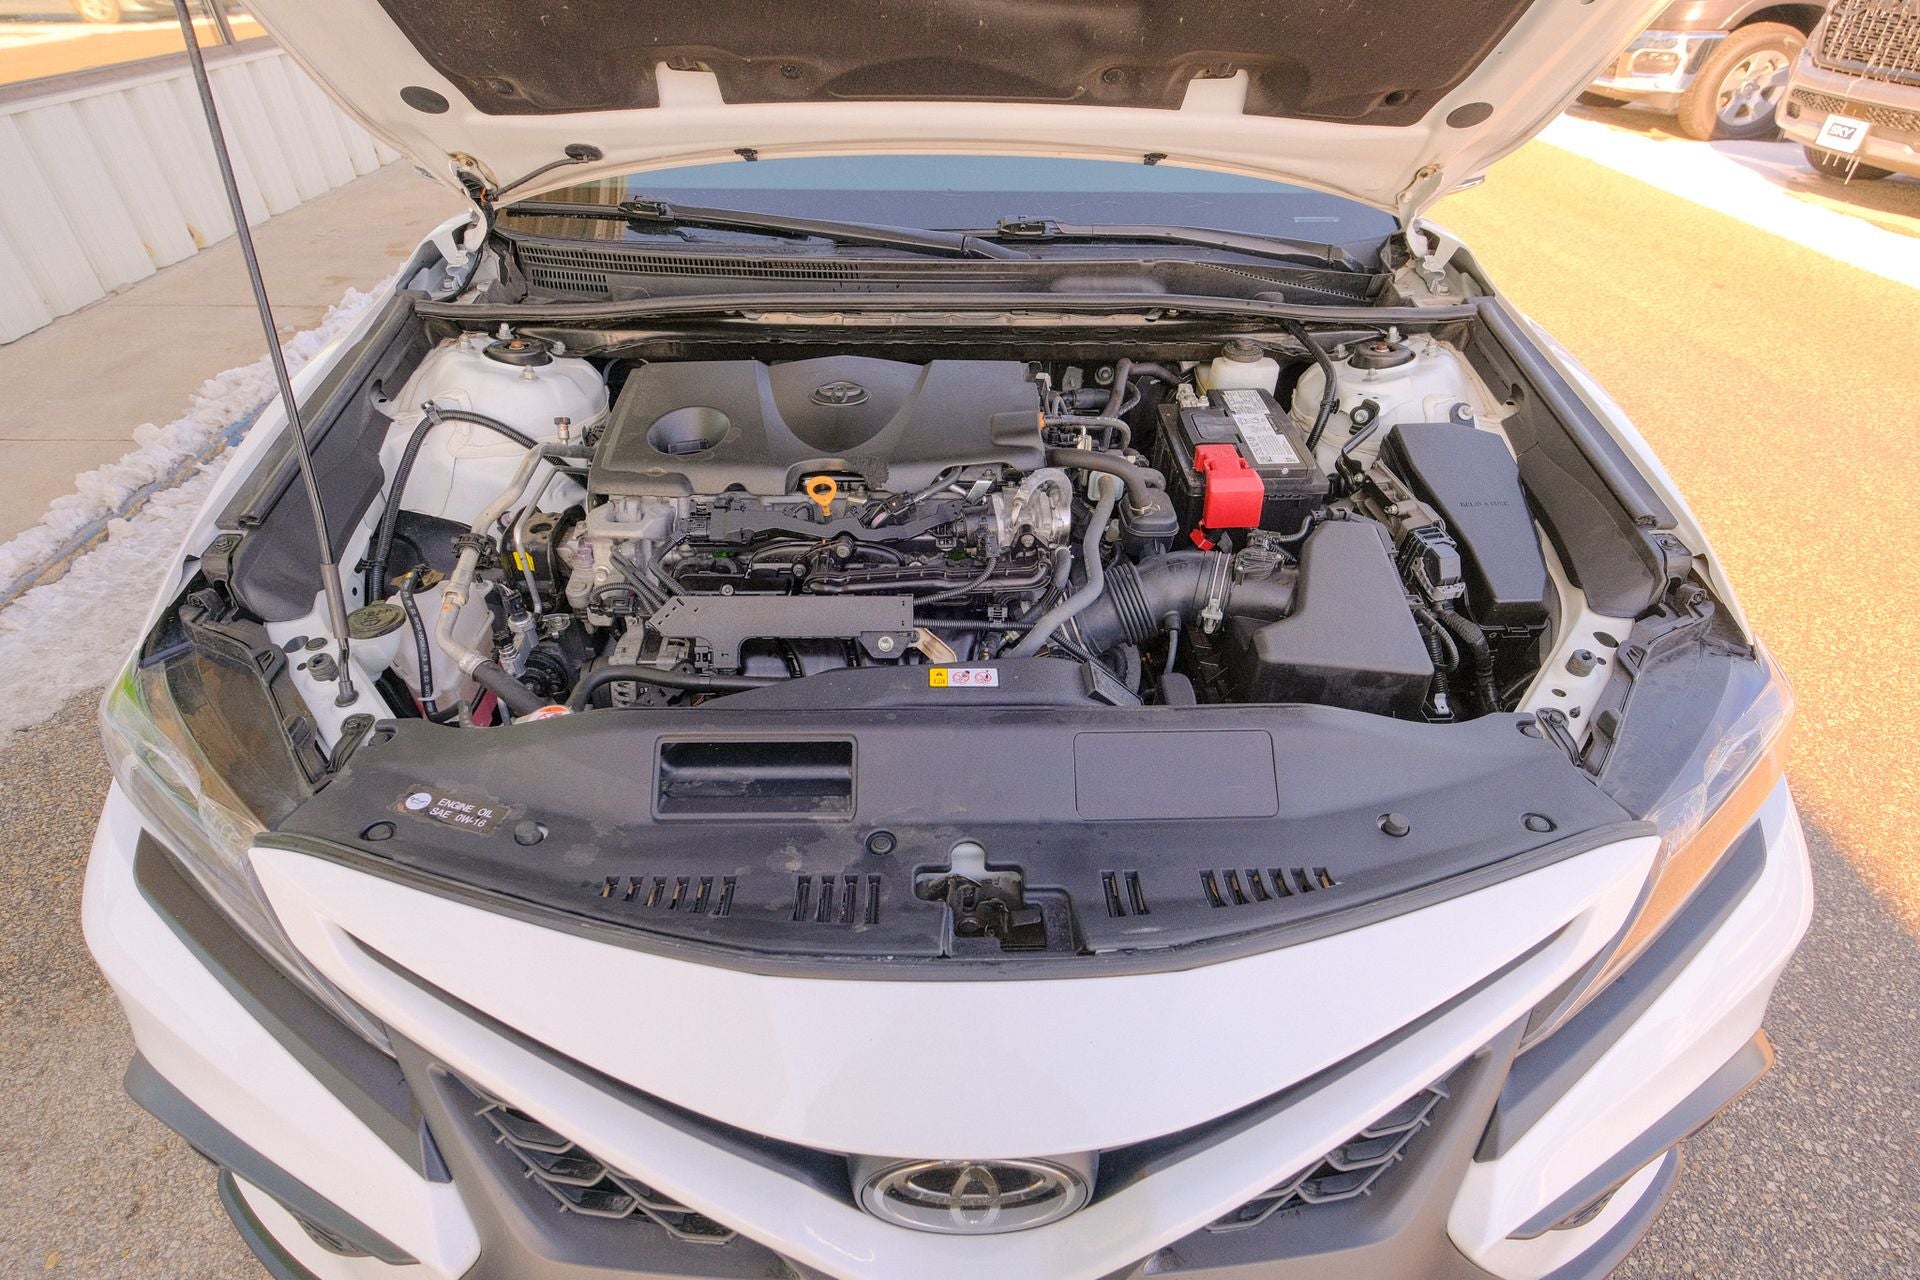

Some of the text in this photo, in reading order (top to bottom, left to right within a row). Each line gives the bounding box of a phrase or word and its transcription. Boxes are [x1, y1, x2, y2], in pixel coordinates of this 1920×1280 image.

[1829, 124, 1855, 138] SKY
[429, 807, 488, 827] SAE 0W-16
[438, 798, 494, 818] ENGINE OIL
